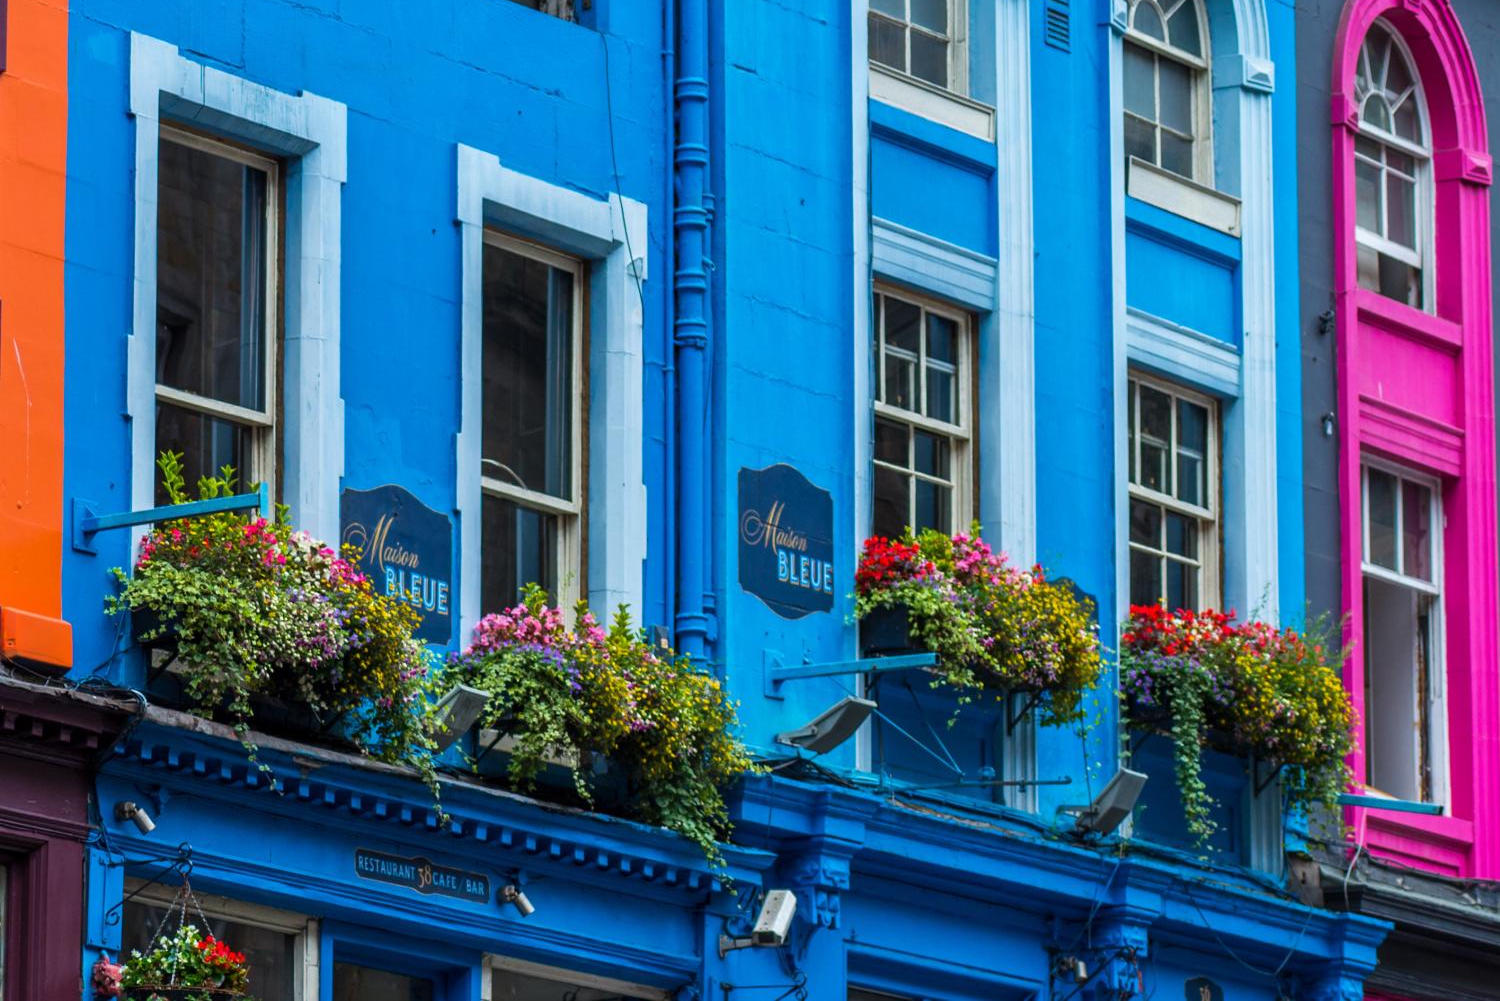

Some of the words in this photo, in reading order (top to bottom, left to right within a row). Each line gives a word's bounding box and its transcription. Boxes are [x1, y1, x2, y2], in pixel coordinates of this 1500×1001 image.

[343, 513, 419, 574] Maison
[741, 500, 808, 555] Maison
[385, 565, 449, 616] BLEUE
[777, 549, 833, 595] BLEUE
[358, 855, 416, 880] RESTAURANT
[417, 864, 432, 888] 38
[466, 879, 485, 895] BAR
